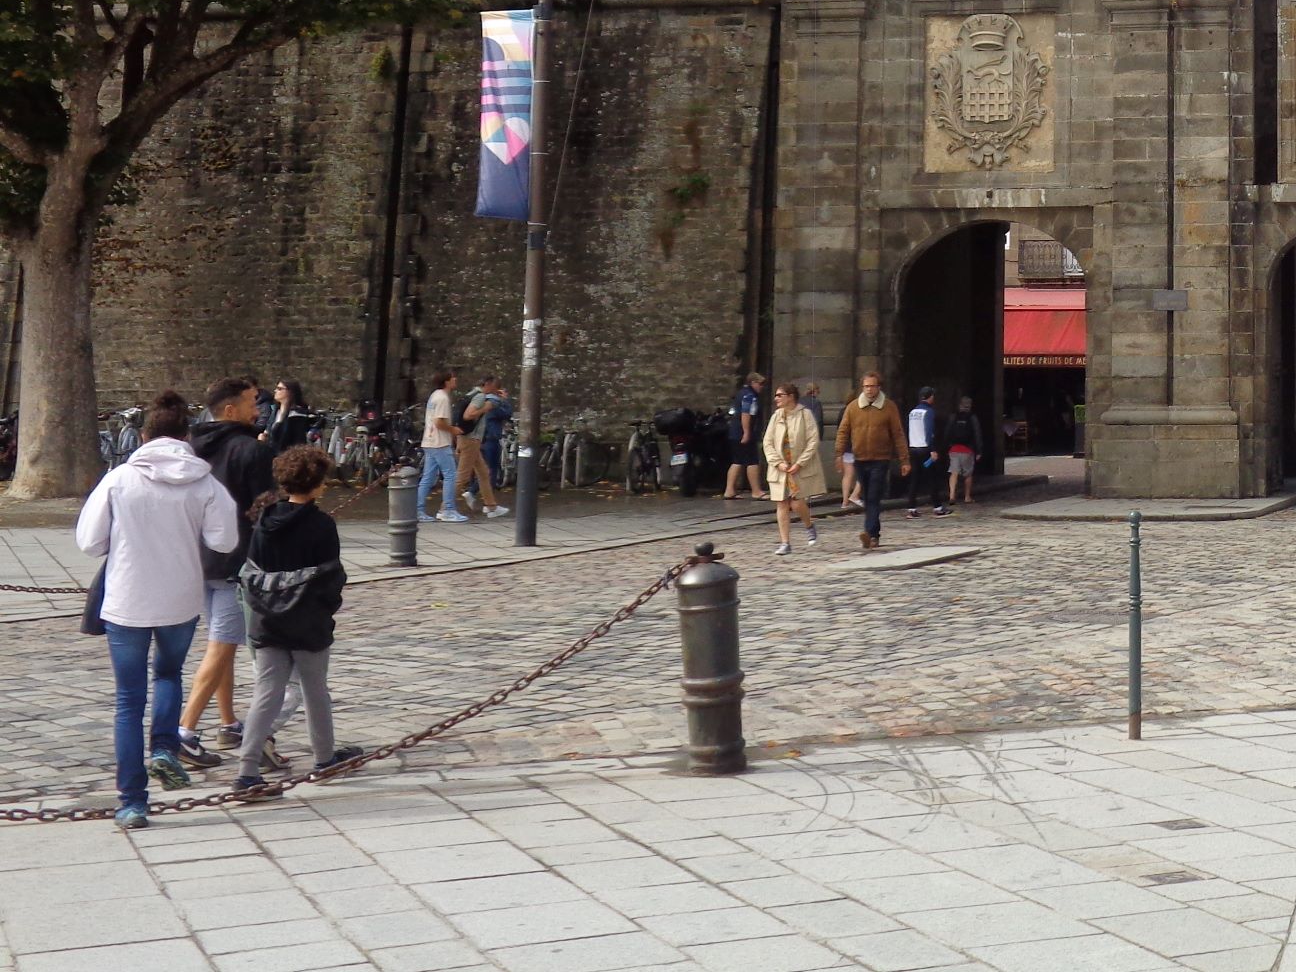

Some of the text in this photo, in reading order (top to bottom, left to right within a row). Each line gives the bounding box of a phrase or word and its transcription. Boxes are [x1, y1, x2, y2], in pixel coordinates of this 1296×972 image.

[1026, 356, 1036, 365] DE
[1038, 356, 1062, 365] FRUITS
[1064, 356, 1074, 365] DE
